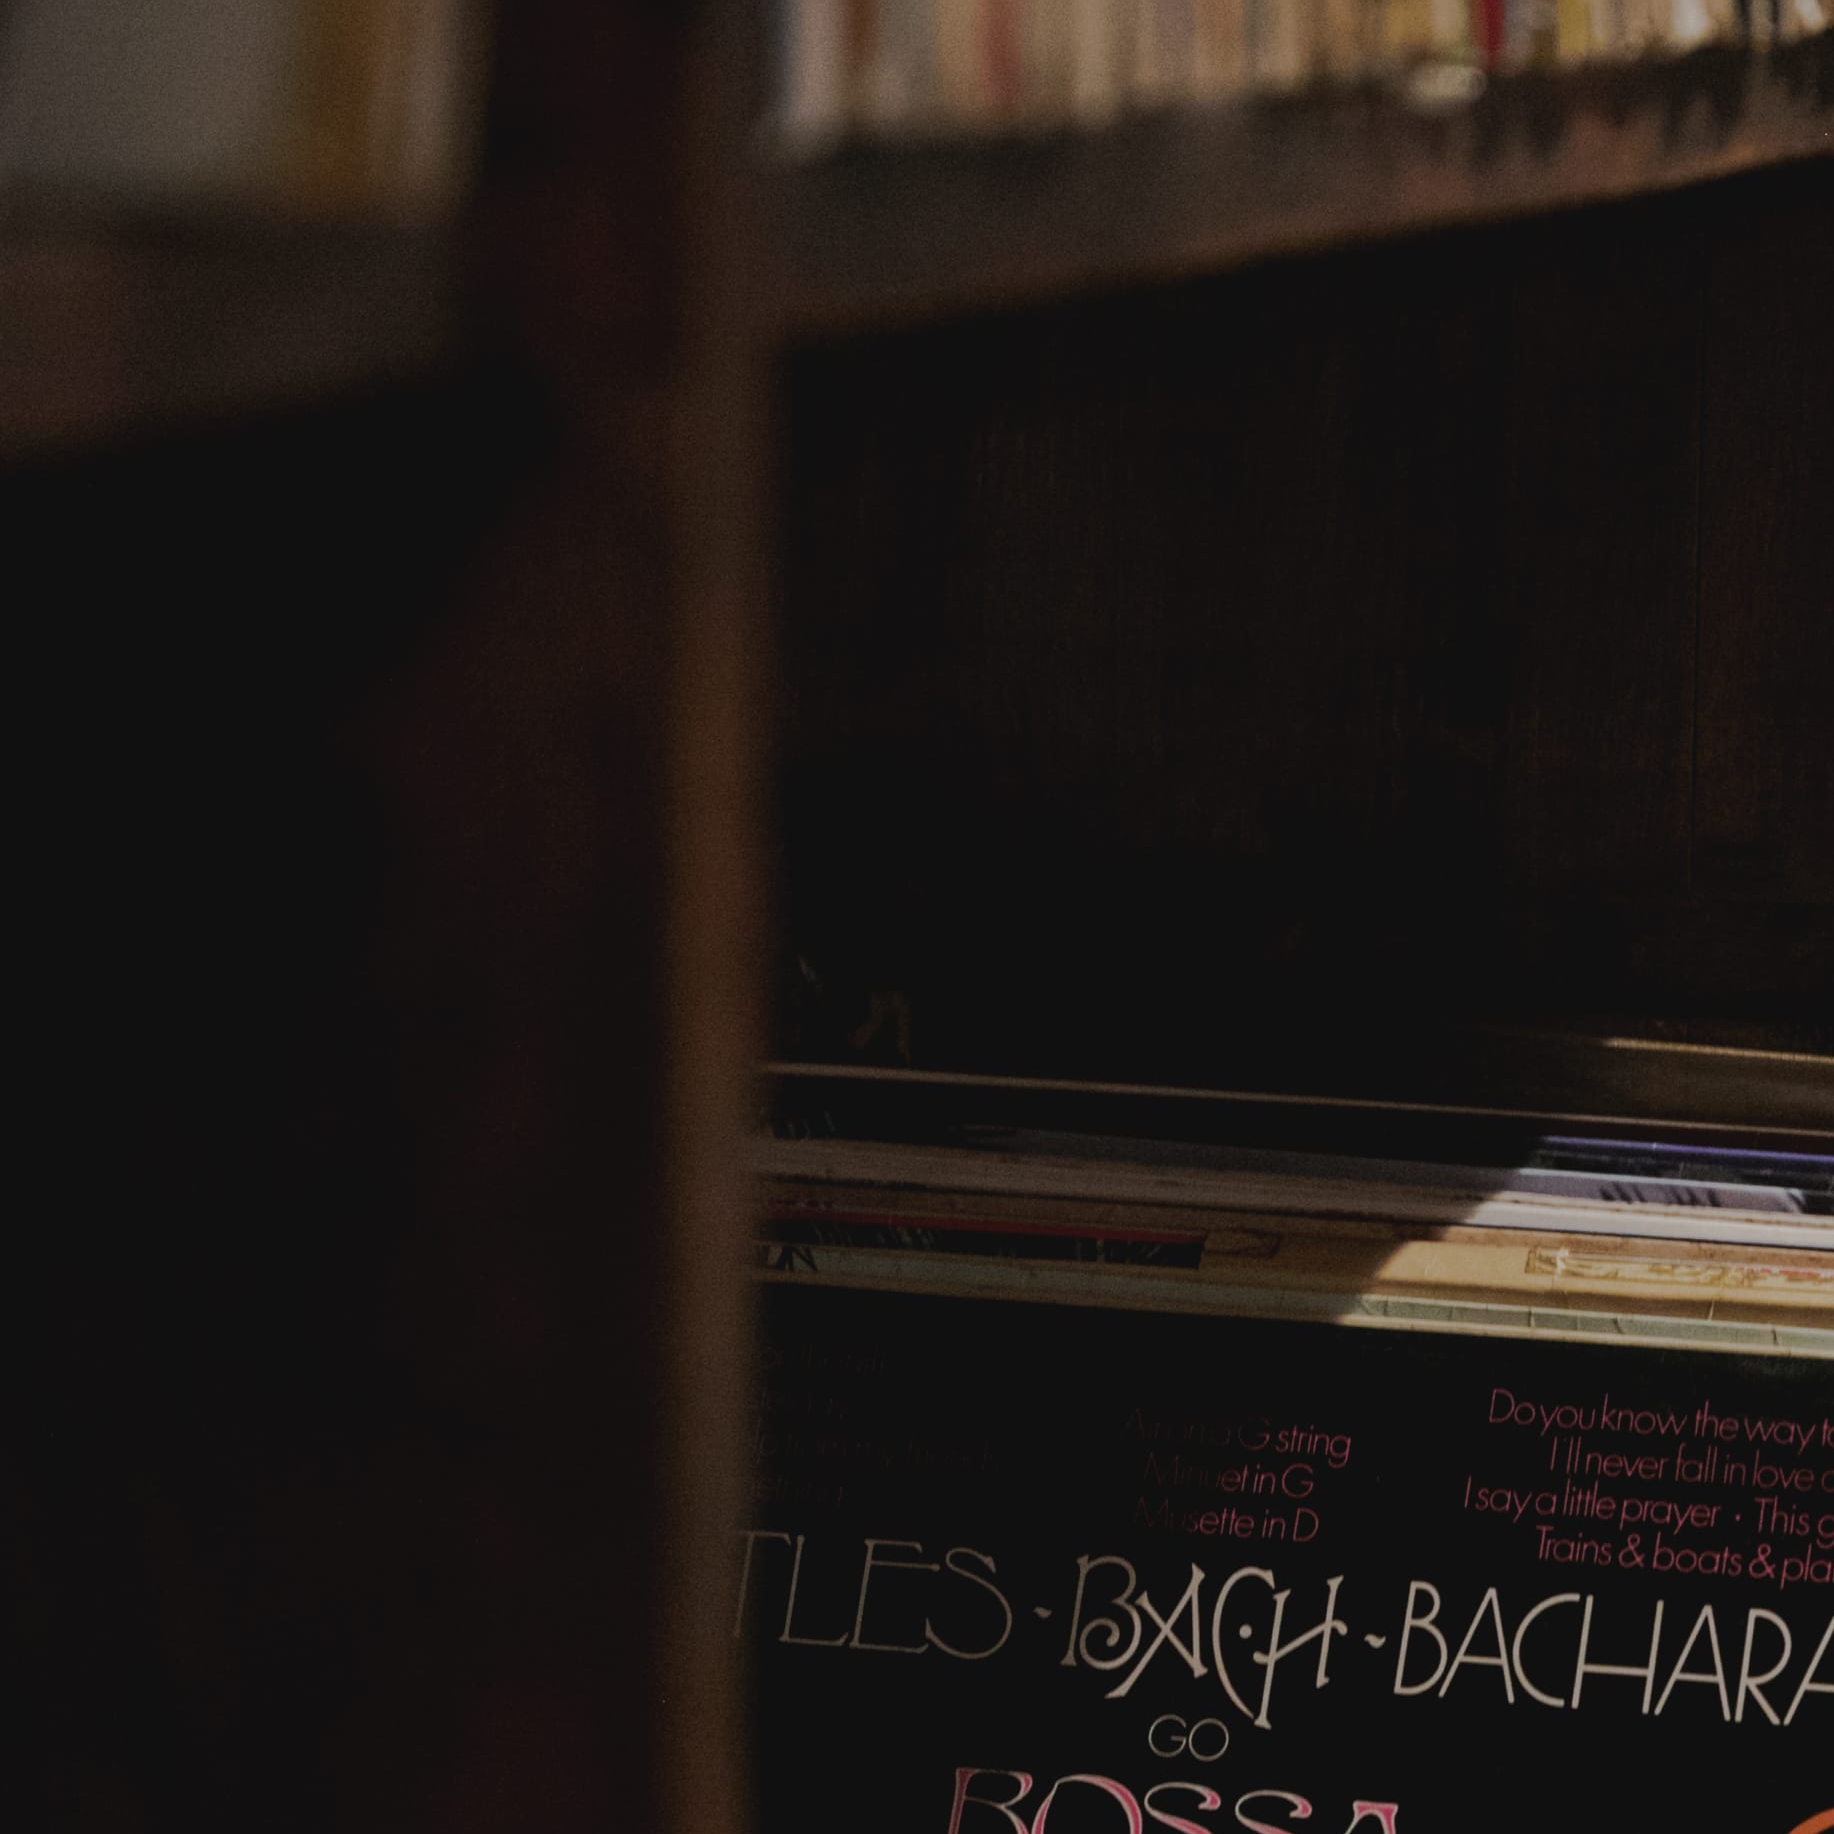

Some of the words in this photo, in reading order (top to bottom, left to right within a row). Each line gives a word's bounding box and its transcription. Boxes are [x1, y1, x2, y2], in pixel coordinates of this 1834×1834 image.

[1238, 1415, 1271, 1452] G
[1274, 1423, 1353, 1470] string
[1488, 1386, 1537, 1425] Do
[1538, 1403, 1597, 1438] you
[1600, 1391, 1689, 1438] know
[1694, 1398, 1740, 1443] the
[1744, 1418, 1817, 1457] way
[1252, 1463, 1276, 1496] in
[1281, 1462, 1316, 1500] G
[1584, 1451, 1670, 1480] never
[1674, 1441, 1720, 1484] fall
[1723, 1451, 1747, 1487] in
[1751, 1447, 1816, 1493] love
[1261, 1508, 1287, 1542] in
[1291, 1507, 1321, 1544] D
[1463, 1474, 1473, 1510] I
[1475, 1486, 1533, 1525] say
[1535, 1491, 1558, 1516] a
[1562, 1478, 1617, 1521] little
[1618, 1497, 1724, 1536] prayer
[1753, 1495, 1811, 1537] This
[1535, 1524, 1613, 1567] Trains
[1617, 1532, 1647, 1569] &
[1652, 1530, 1743, 1578] boats
[1748, 1543, 1777, 1580] &
[1059, 1554, 1348, 1732] BACH
[1148, 1713, 1230, 1763] GO
